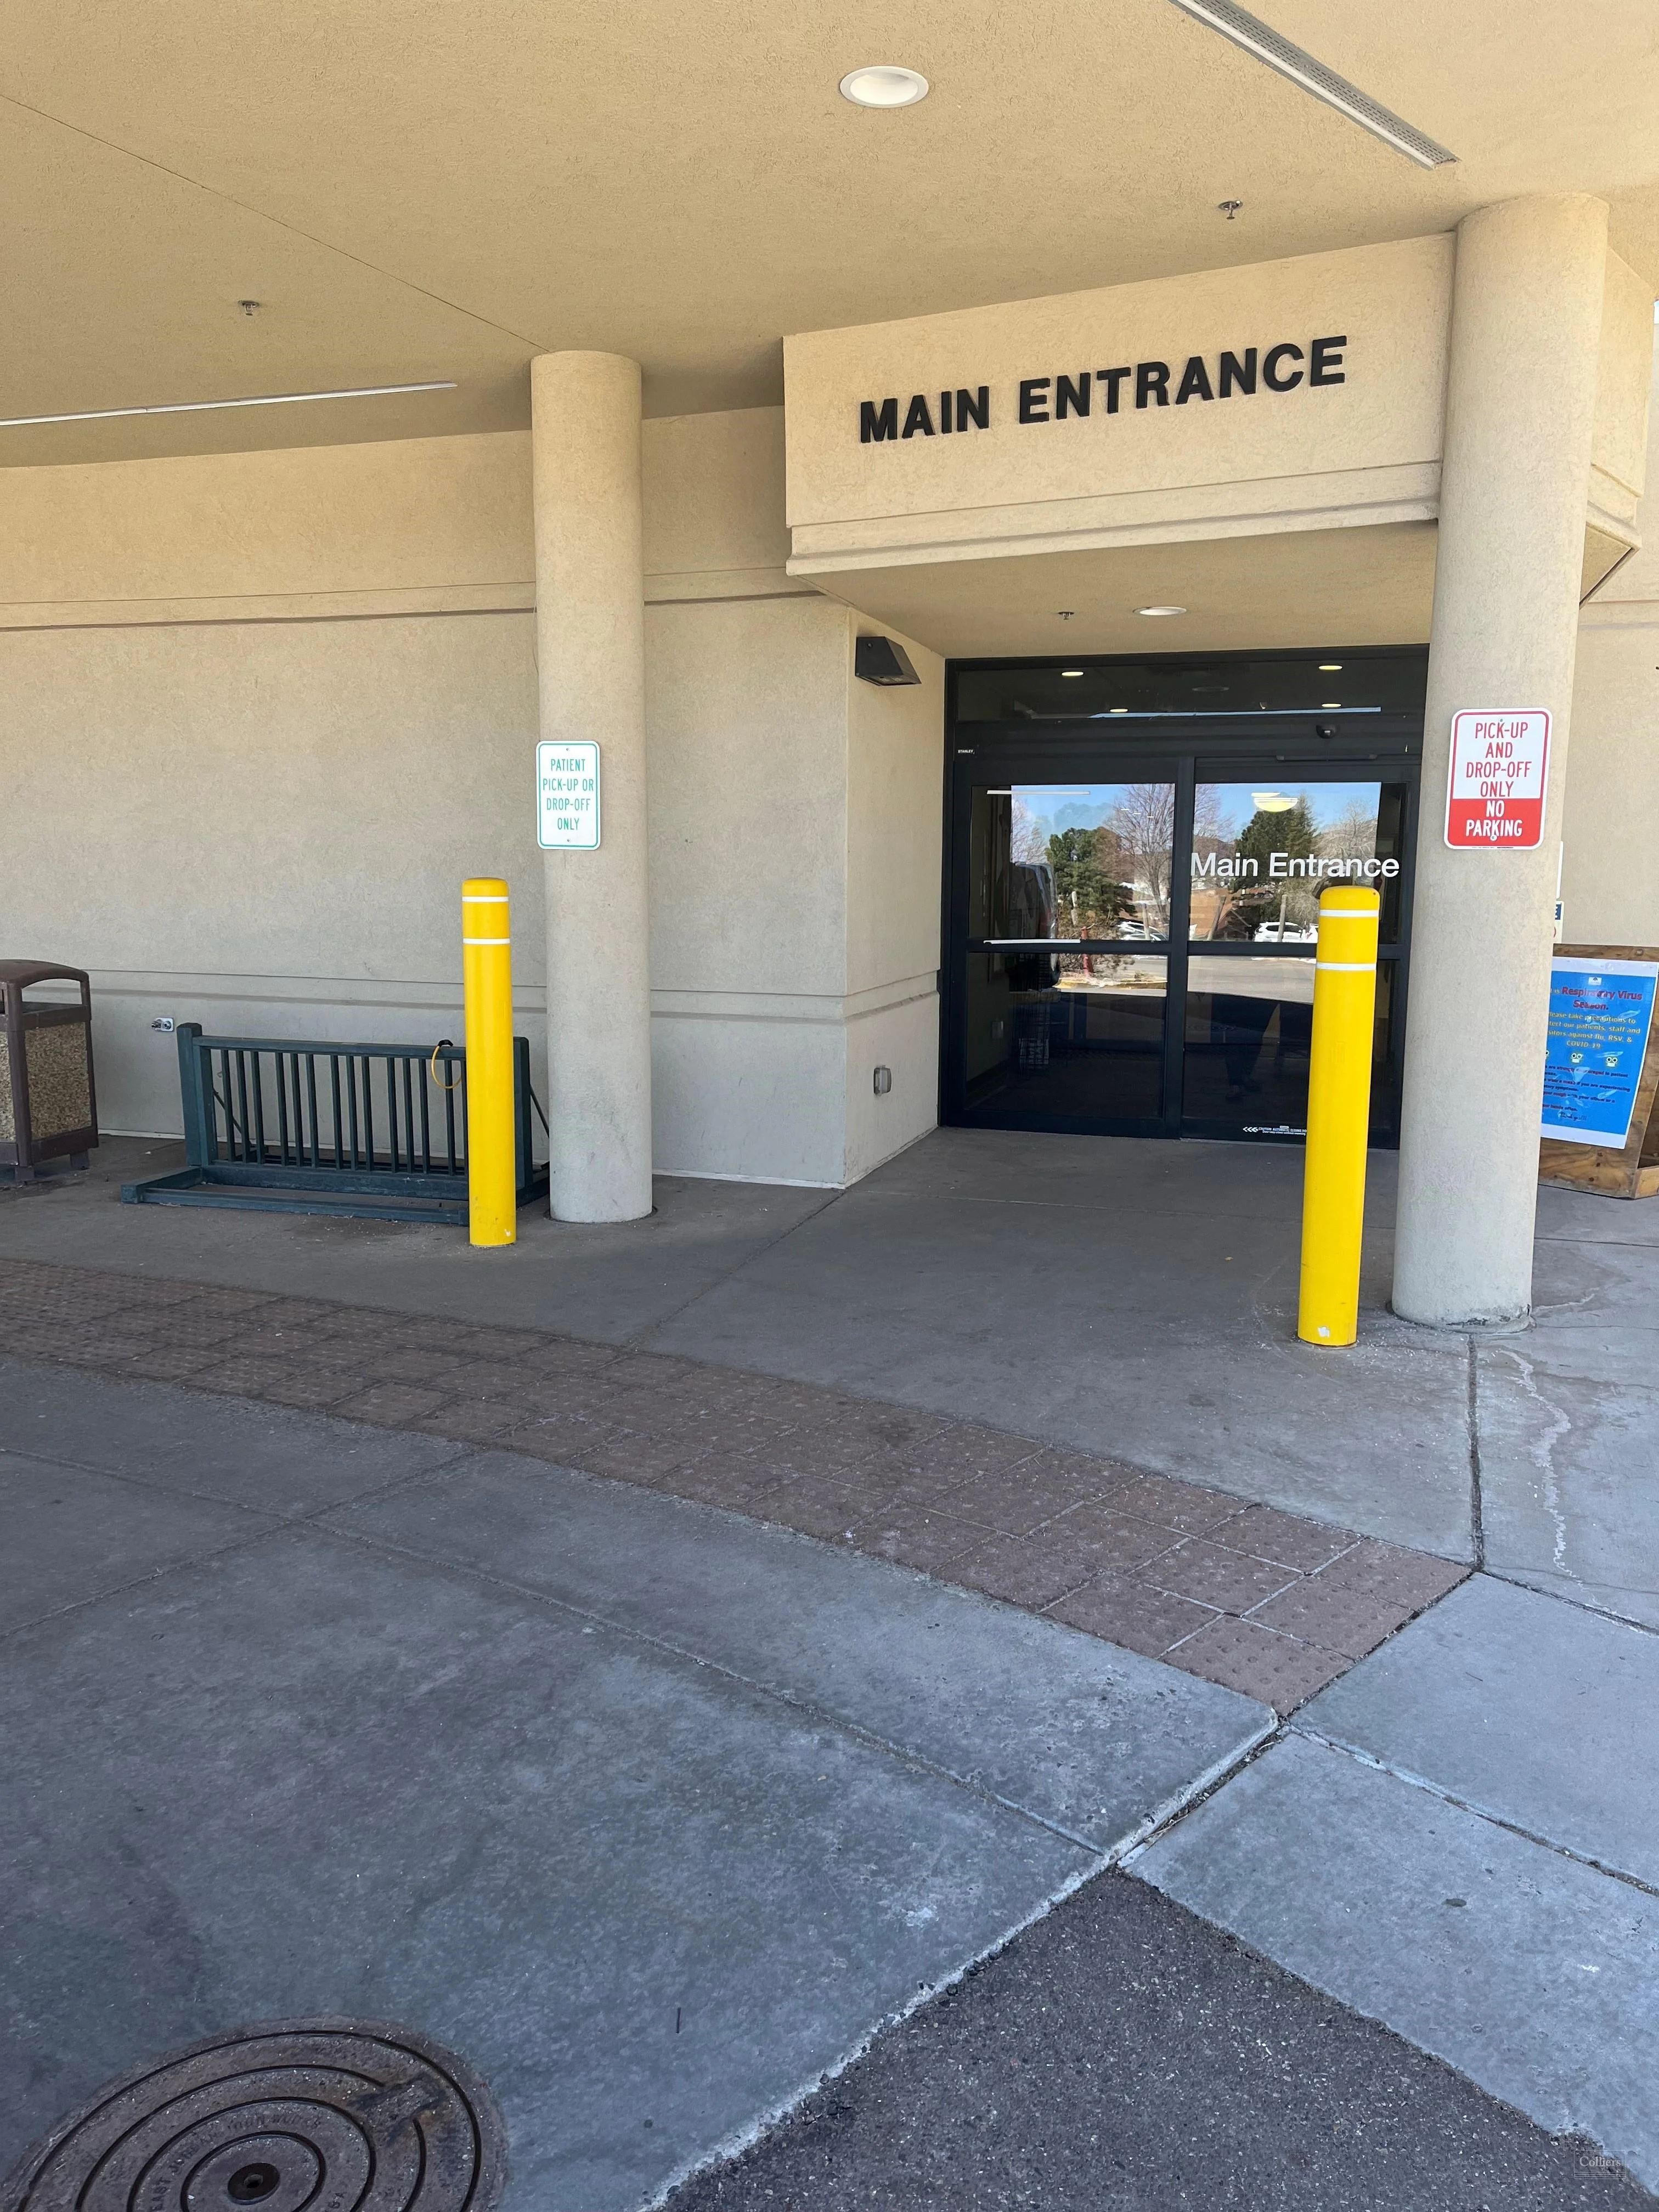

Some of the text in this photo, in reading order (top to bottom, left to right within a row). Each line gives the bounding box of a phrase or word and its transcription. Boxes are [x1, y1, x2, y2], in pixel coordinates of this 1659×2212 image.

[859, 335, 1347, 443] MAIN ENTRANCE
[1475, 722, 1528, 738] PICK-UP
[1485, 742, 1513, 758] AND
[550, 759, 586, 771] PATIENT
[1466, 761, 1532, 778] DROP-OFF
[543, 778, 594, 791] PICK-UP OR
[1480, 781, 1514, 797] ONLY
[546, 798, 591, 811] DROP-OFF
[1486, 800, 1505, 817] NO
[557, 817, 580, 830] ONLY
[1465, 819, 1523, 837] PARKING
[1190, 853, 1400, 878] Main Entrance
[1617, 990, 1643, 1001] Virus
